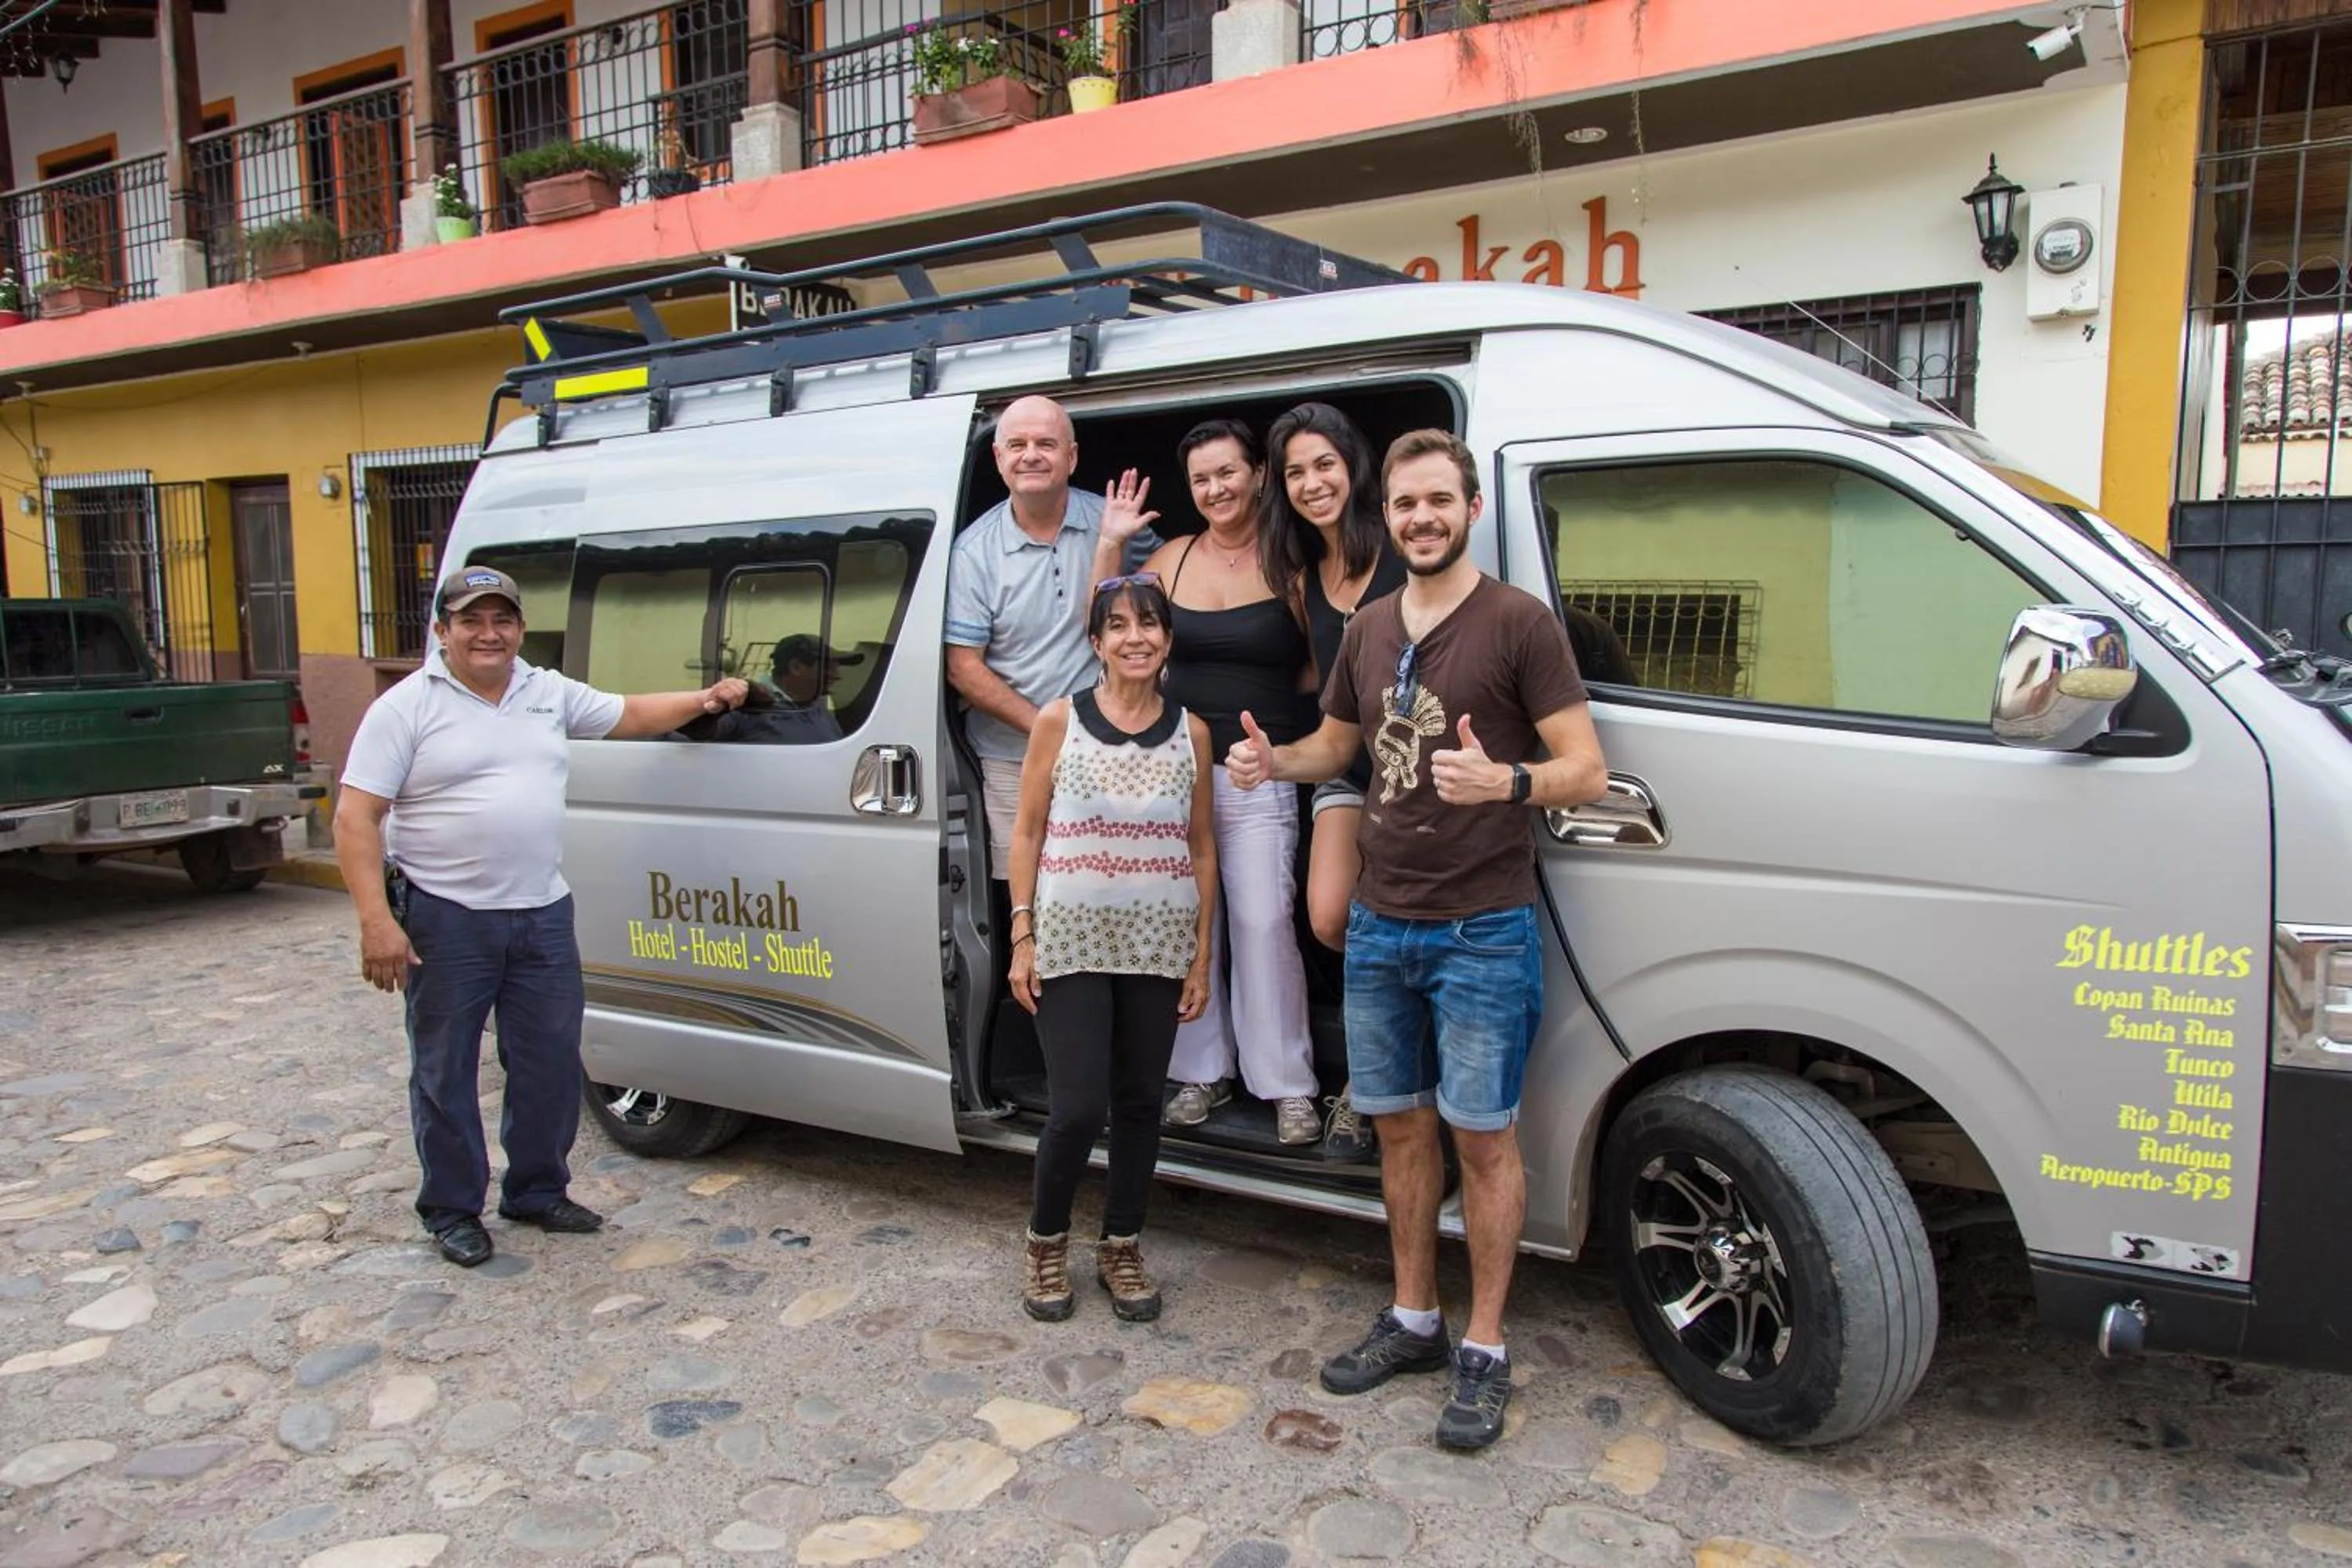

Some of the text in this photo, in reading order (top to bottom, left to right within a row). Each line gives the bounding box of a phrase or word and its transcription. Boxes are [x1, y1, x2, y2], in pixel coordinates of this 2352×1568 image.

[648, 871, 800, 931] Berakah
[629, 921, 677, 960] Hotel
[690, 927, 749, 971] Hostel
[765, 932, 833, 979] Shuttle
[2056, 924, 2252, 978] Shuttles
[2074, 982, 2234, 1016] Copan Ruinas
[2104, 1014, 2234, 1047] Santa Ana
[2165, 1048, 2234, 1078] Tunco
[2174, 1080, 2233, 1109] Utila
[2118, 1104, 2234, 1141] Rio Dulce
[2138, 1136, 2232, 1171] Antigua
[2040, 1154, 2232, 1200] Aeropuerto-SPS
